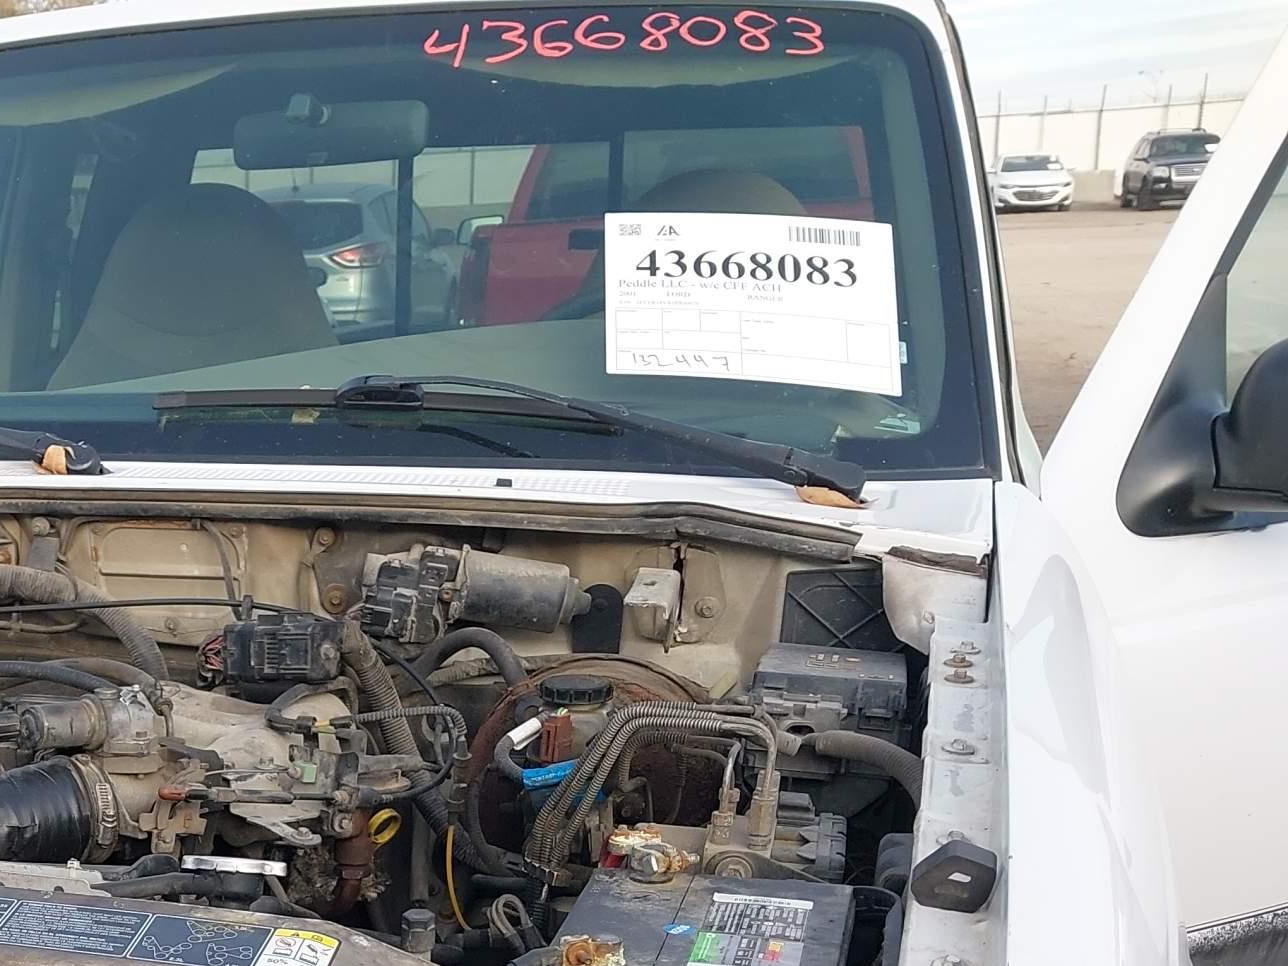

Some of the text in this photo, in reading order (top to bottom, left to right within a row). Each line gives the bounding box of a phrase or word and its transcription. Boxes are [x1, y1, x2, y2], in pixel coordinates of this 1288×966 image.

[423, 10, 825, 68] 43668083
[619, 279, 657, 288] Peddle
[662, 280, 688, 289] LLC
[636, 249, 857, 288] 43668083
